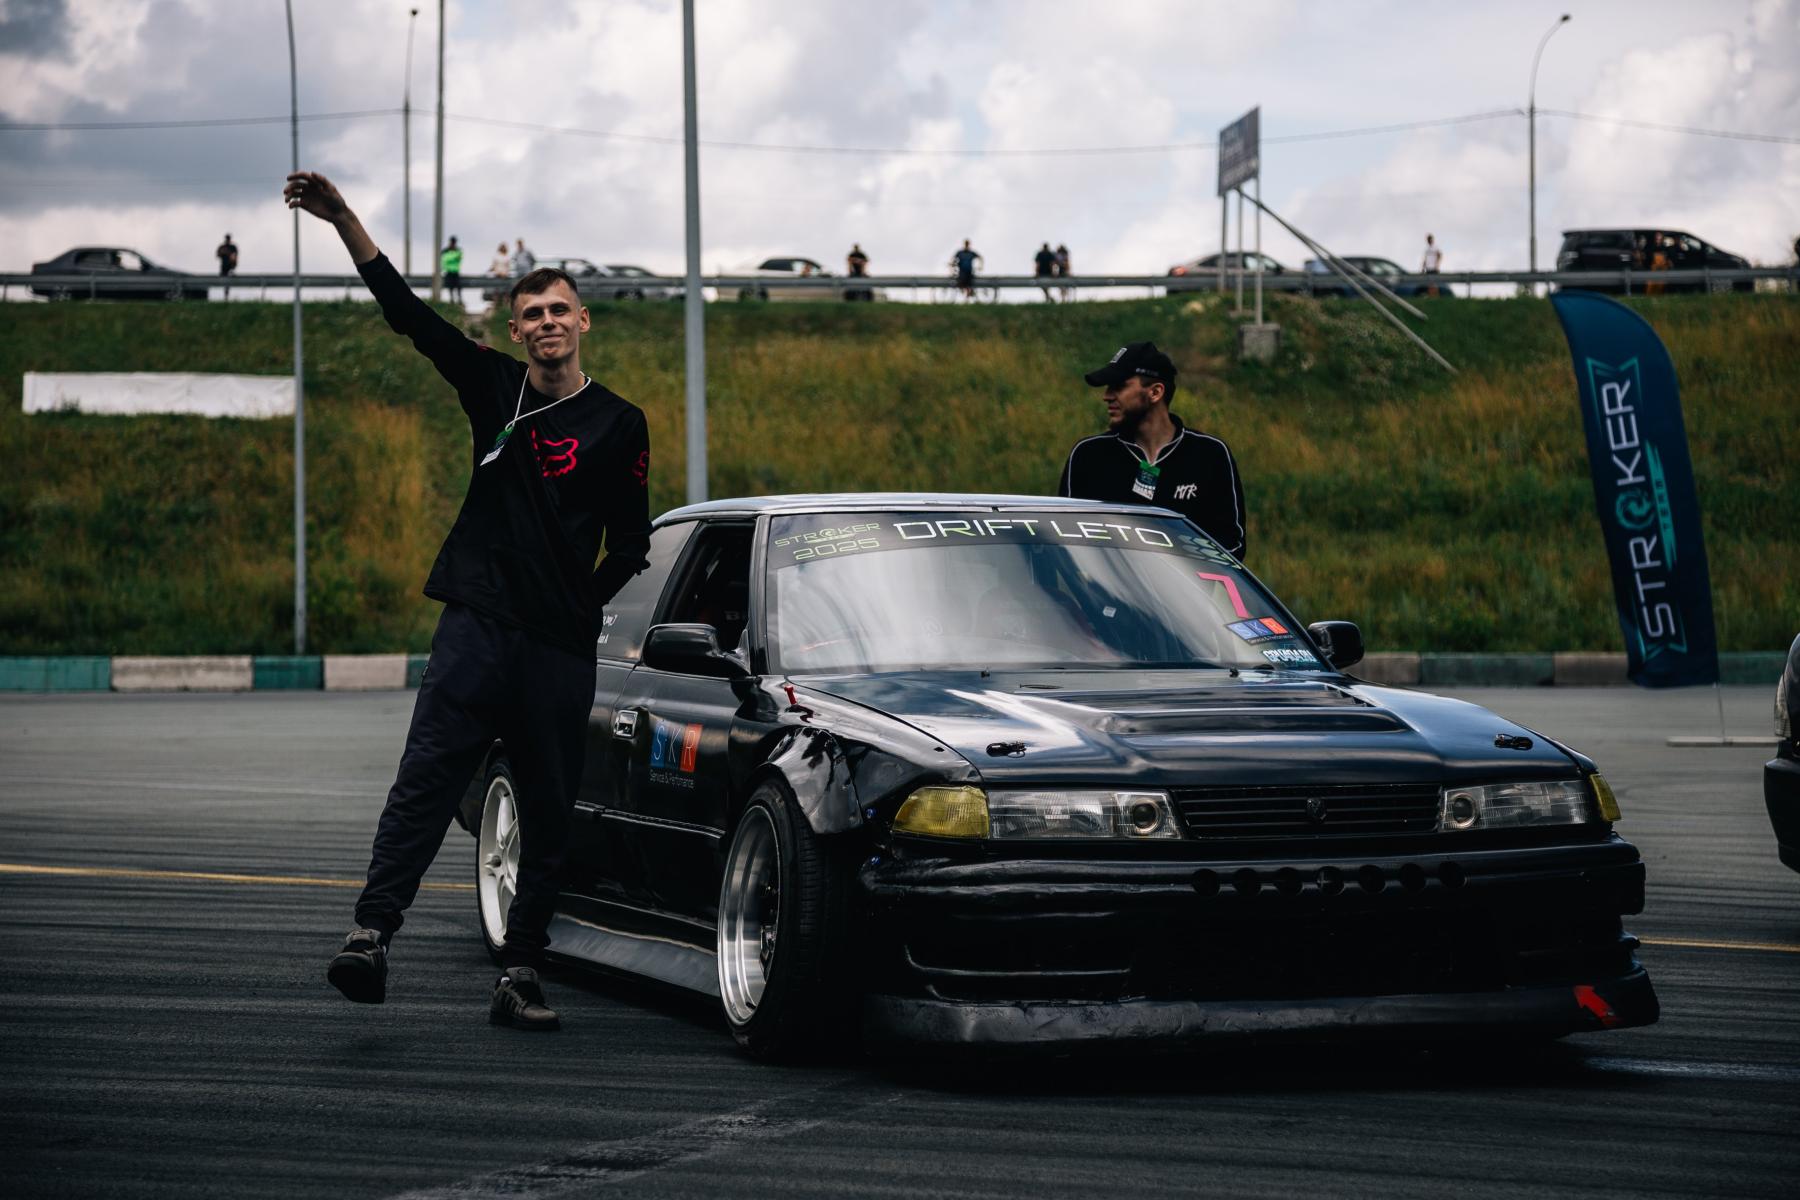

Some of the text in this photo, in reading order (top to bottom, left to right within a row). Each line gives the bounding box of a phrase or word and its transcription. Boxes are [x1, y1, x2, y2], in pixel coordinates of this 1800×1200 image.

[1174, 483, 1197, 499] MTR
[893, 520, 1173, 547] DRIFT LETO
[793, 538, 880, 560] 2025
[1196, 571, 1250, 619] 7
